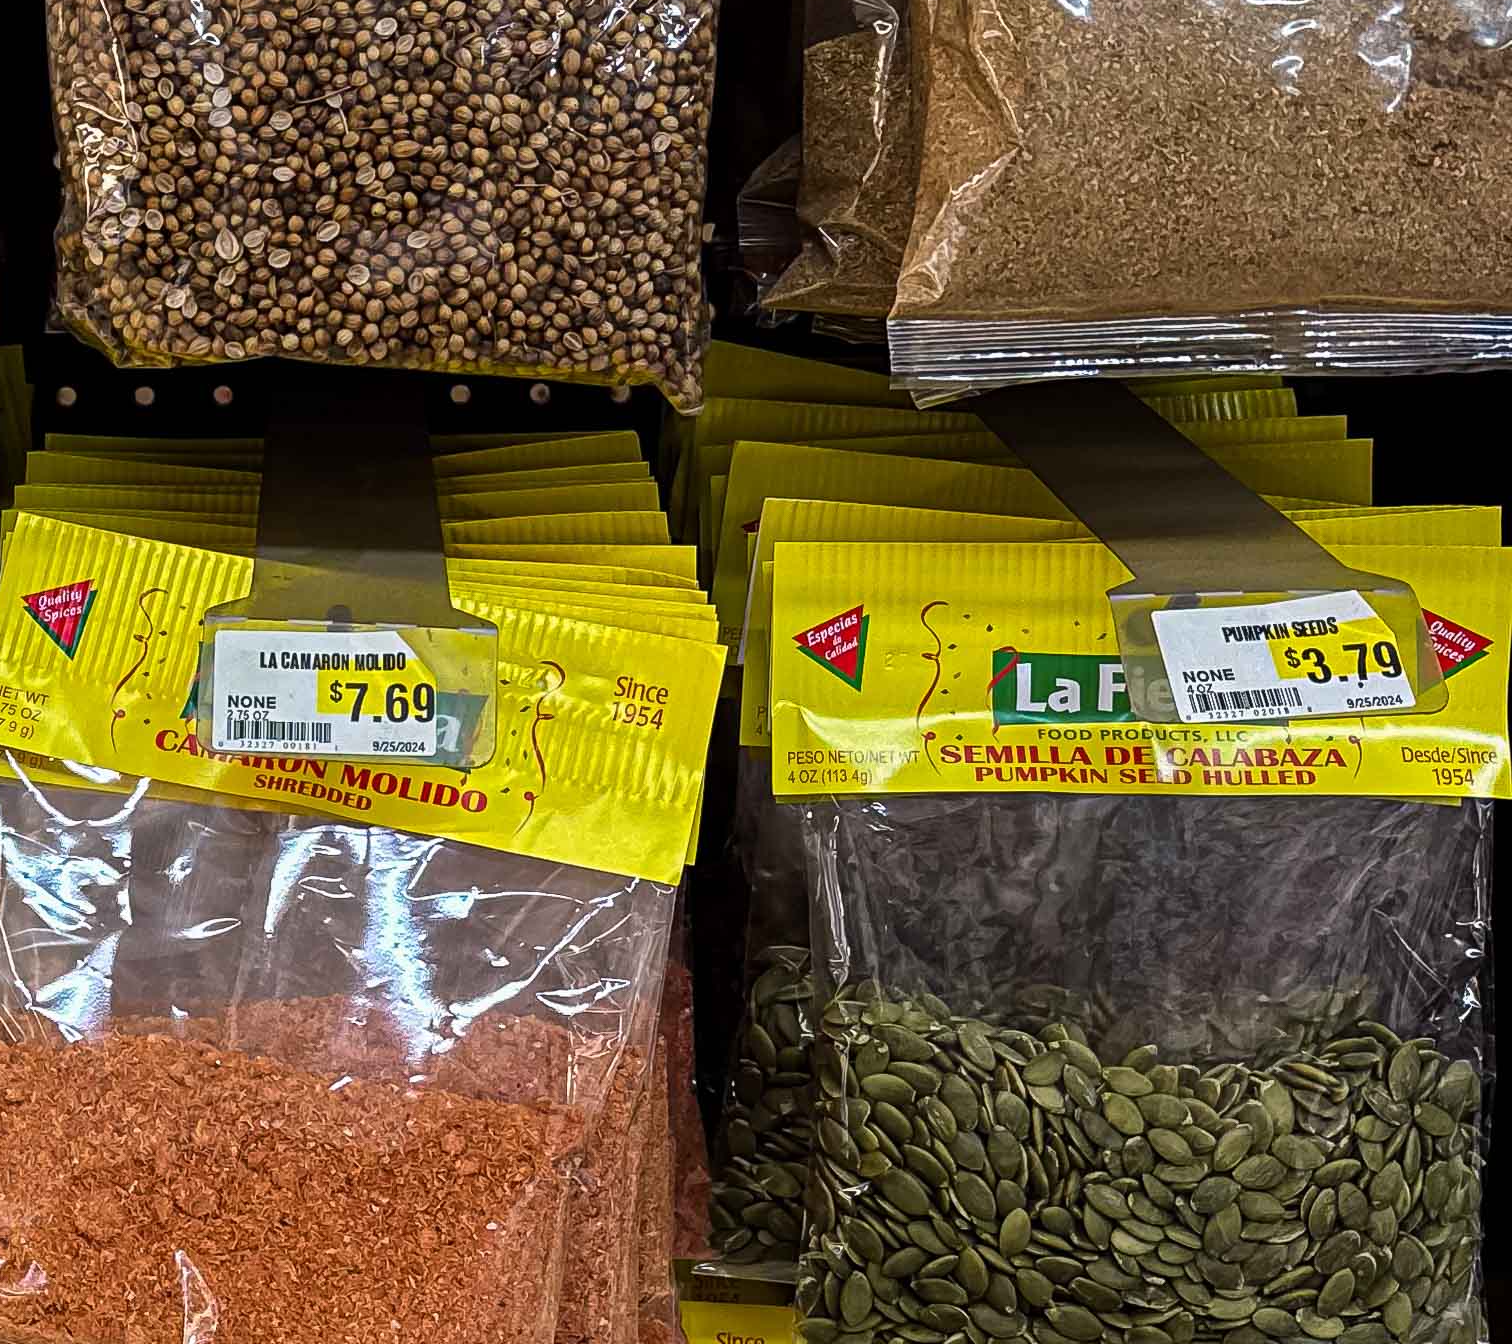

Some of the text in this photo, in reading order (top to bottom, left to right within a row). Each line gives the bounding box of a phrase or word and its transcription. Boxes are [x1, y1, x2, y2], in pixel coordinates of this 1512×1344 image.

[38, 588, 82, 611] Quality
[43, 605, 82, 623] Spices
[806, 613, 858, 647] Especias
[1221, 616, 1339, 643] PUMPKIN SEEDS
[1428, 621, 1477, 652] Quality
[824, 637, 859, 661] Calidad
[260, 652, 406, 671] LA CAMARON MOLIDO
[1283, 641, 1403, 685] $3.79
[1015, 662, 1080, 713] La
[1182, 668, 1236, 684] NONE
[26, 691, 50, 706] WT
[330, 680, 435, 723] $7.69
[614, 676, 668, 705] Since
[227, 695, 277, 710] NONE
[1346, 696, 1403, 709] 9/25/2024
[612, 701, 663, 730] 1954
[372, 741, 426, 753] 9/25/2024
[1037, 728, 1250, 743] FOOD PRODUCTS, LLC
[787, 750, 895, 765] PESO NETO/NET
[940, 744, 1348, 768] SEMILLA DE CALABAZA
[1401, 746, 1497, 765] Desde/Since
[974, 767, 1317, 786] PUMPKIN SEED HULLED
[1432, 768, 1475, 787] 1954
[254, 773, 373, 812] SHREDDED
[340, 763, 489, 814] MOLIDO
